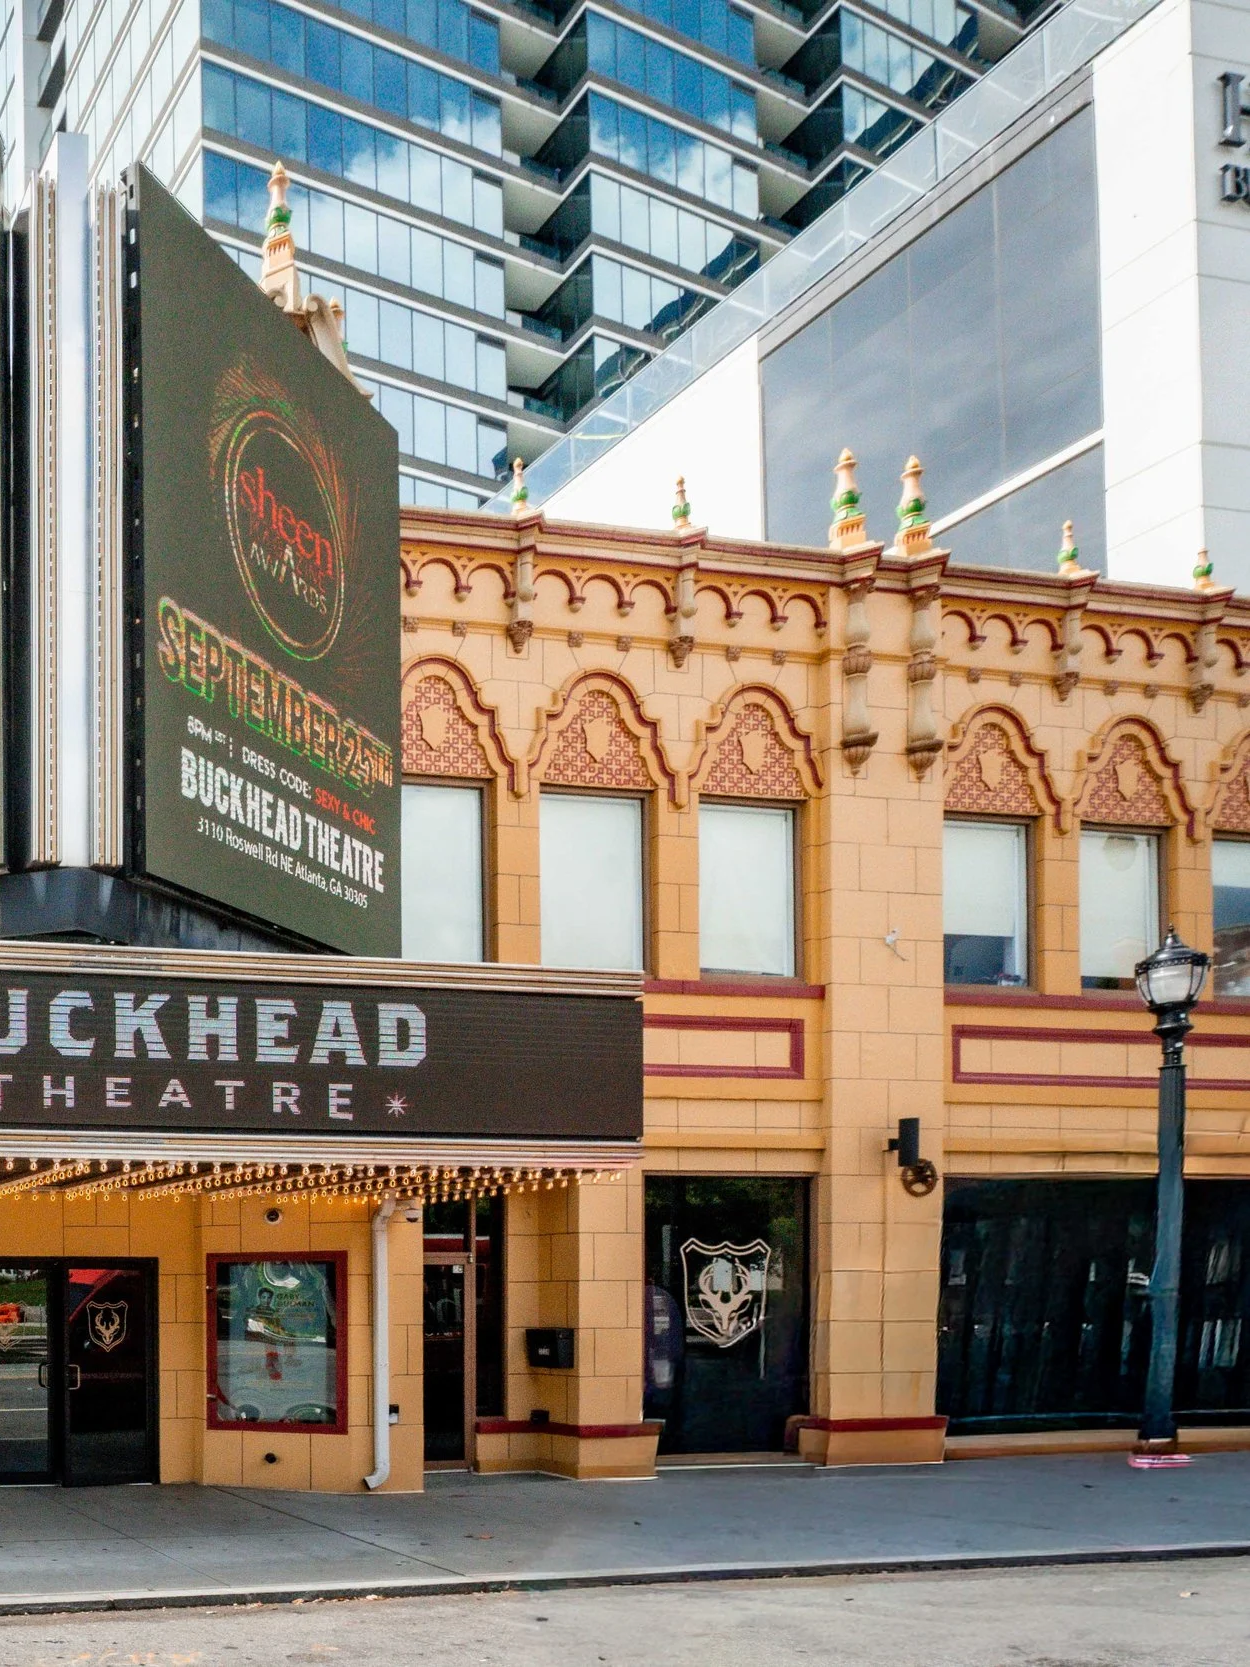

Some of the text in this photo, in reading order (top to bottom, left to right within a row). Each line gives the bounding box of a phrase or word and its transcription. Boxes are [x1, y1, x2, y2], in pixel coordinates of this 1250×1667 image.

[240, 466, 334, 578] sheen
[157, 596, 340, 780] SEPTEMBER
[181, 746, 385, 894] BUCKHEAD THEATRE
[242, 746, 276, 779] DRESS
[279, 768, 311, 800] CODE:
[315, 787, 341, 814] SEXY
[342, 802, 352, 821] &
[352, 809, 377, 836] CHIC
[197, 816, 368, 909] 3110 Roswell Rd NE Atlanta, GA 30305
